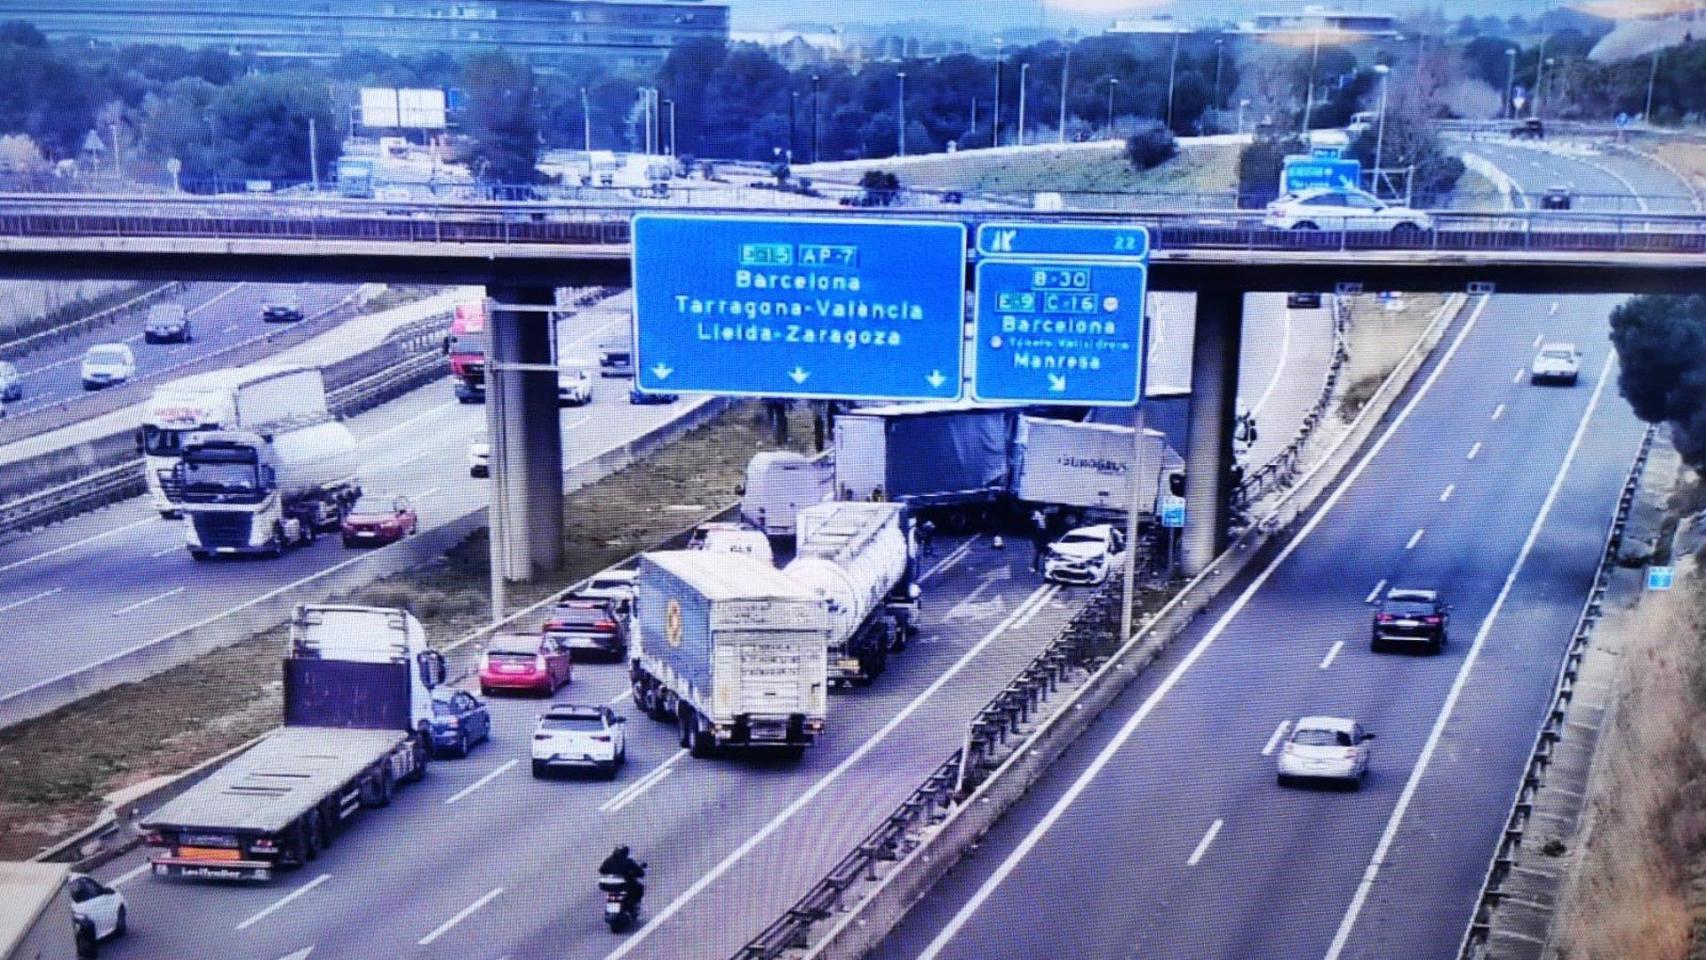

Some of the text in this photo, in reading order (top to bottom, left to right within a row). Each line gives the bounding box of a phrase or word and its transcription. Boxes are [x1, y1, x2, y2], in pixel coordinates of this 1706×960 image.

[1113, 236, 1136, 250] 22
[742, 245, 856, 265] E-15 AP-7
[736, 269, 861, 291] Barcelona
[1034, 271, 1086, 287] B-30
[999, 293, 1094, 312] E-9 C-16
[1002, 315, 1116, 335] Barcelona
[1013, 352, 1101, 370] Manresa
